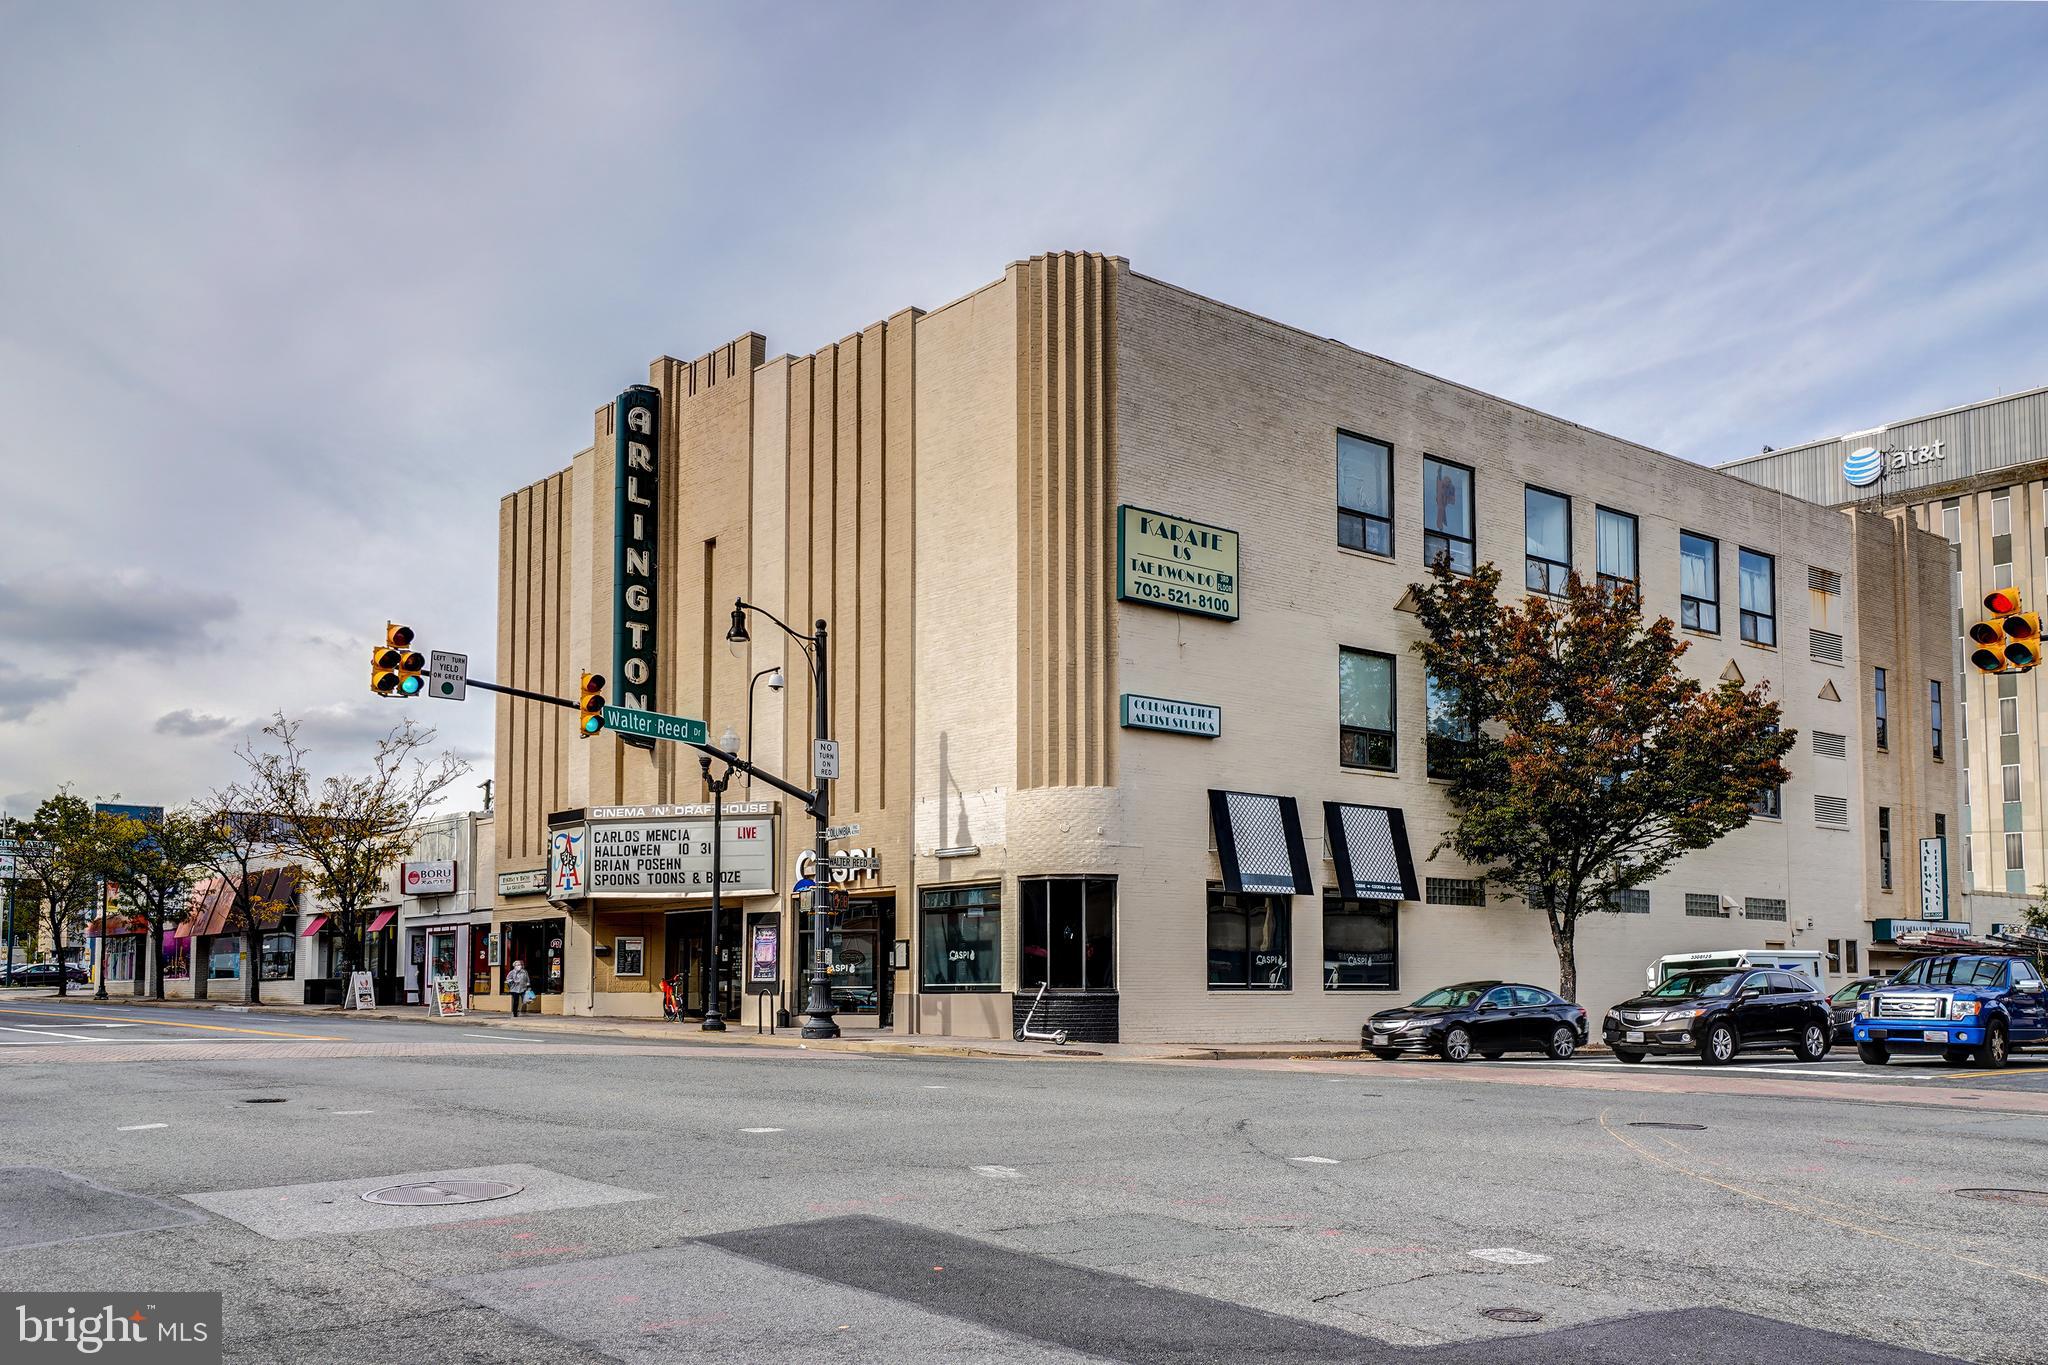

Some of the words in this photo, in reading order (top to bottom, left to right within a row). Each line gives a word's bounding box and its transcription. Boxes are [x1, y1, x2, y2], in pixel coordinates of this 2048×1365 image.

[1892, 439, 1945, 469] at&t
[1141, 517, 1222, 553] KARATE
[1173, 544, 1192, 562] US
[1130, 558, 1155, 575] TAE
[1157, 564, 1194, 584] KWON
[1197, 572, 1215, 589] DO
[1133, 581, 1229, 613] 703-521-8100
[433, 654, 446, 662] LEFT
[452, 656, 466, 665] TURN
[439, 663, 460, 673] YIELD
[433, 671, 443, 679] ON
[444, 673, 464, 682] GREEN
[1133, 699, 1187, 719] COLUMBIA
[1190, 706, 1215, 721] PIKE
[608, 710, 652, 733] Walter
[657, 719, 689, 739] Reed
[693, 728, 702, 738] Dr
[1133, 713, 1170, 728] ARTIST
[1172, 718, 1215, 733] STUDIOS
[820, 743, 833, 751] NO
[819, 752, 834, 760] TURN
[593, 808, 645, 818] CINEMA
[674, 803, 768, 816] DRAFHOUSE
[594, 830, 640, 844] CARLOS
[646, 829, 690, 842] MENCIA
[737, 827, 757, 839] LIVE
[594, 843, 661, 858] HALLOWEEN
[678, 843, 689, 855] 10
[700, 842, 711, 855] 31
[594, 858, 629, 872] BRIAN
[637, 858, 681, 871] POSEHN
[829, 856, 850, 867] WALTER
[852, 857, 868, 868] REED
[421, 869, 451, 878] BORU
[594, 873, 640, 886] SPOONS
[647, 871, 686, 885] TOONS
[692, 872, 701, 884] &
[706, 870, 741, 884] BOZE
[949, 950, 970, 961] CASPI
[1256, 955, 1278, 965] CASPI
[831, 963, 849, 973] ASPI
